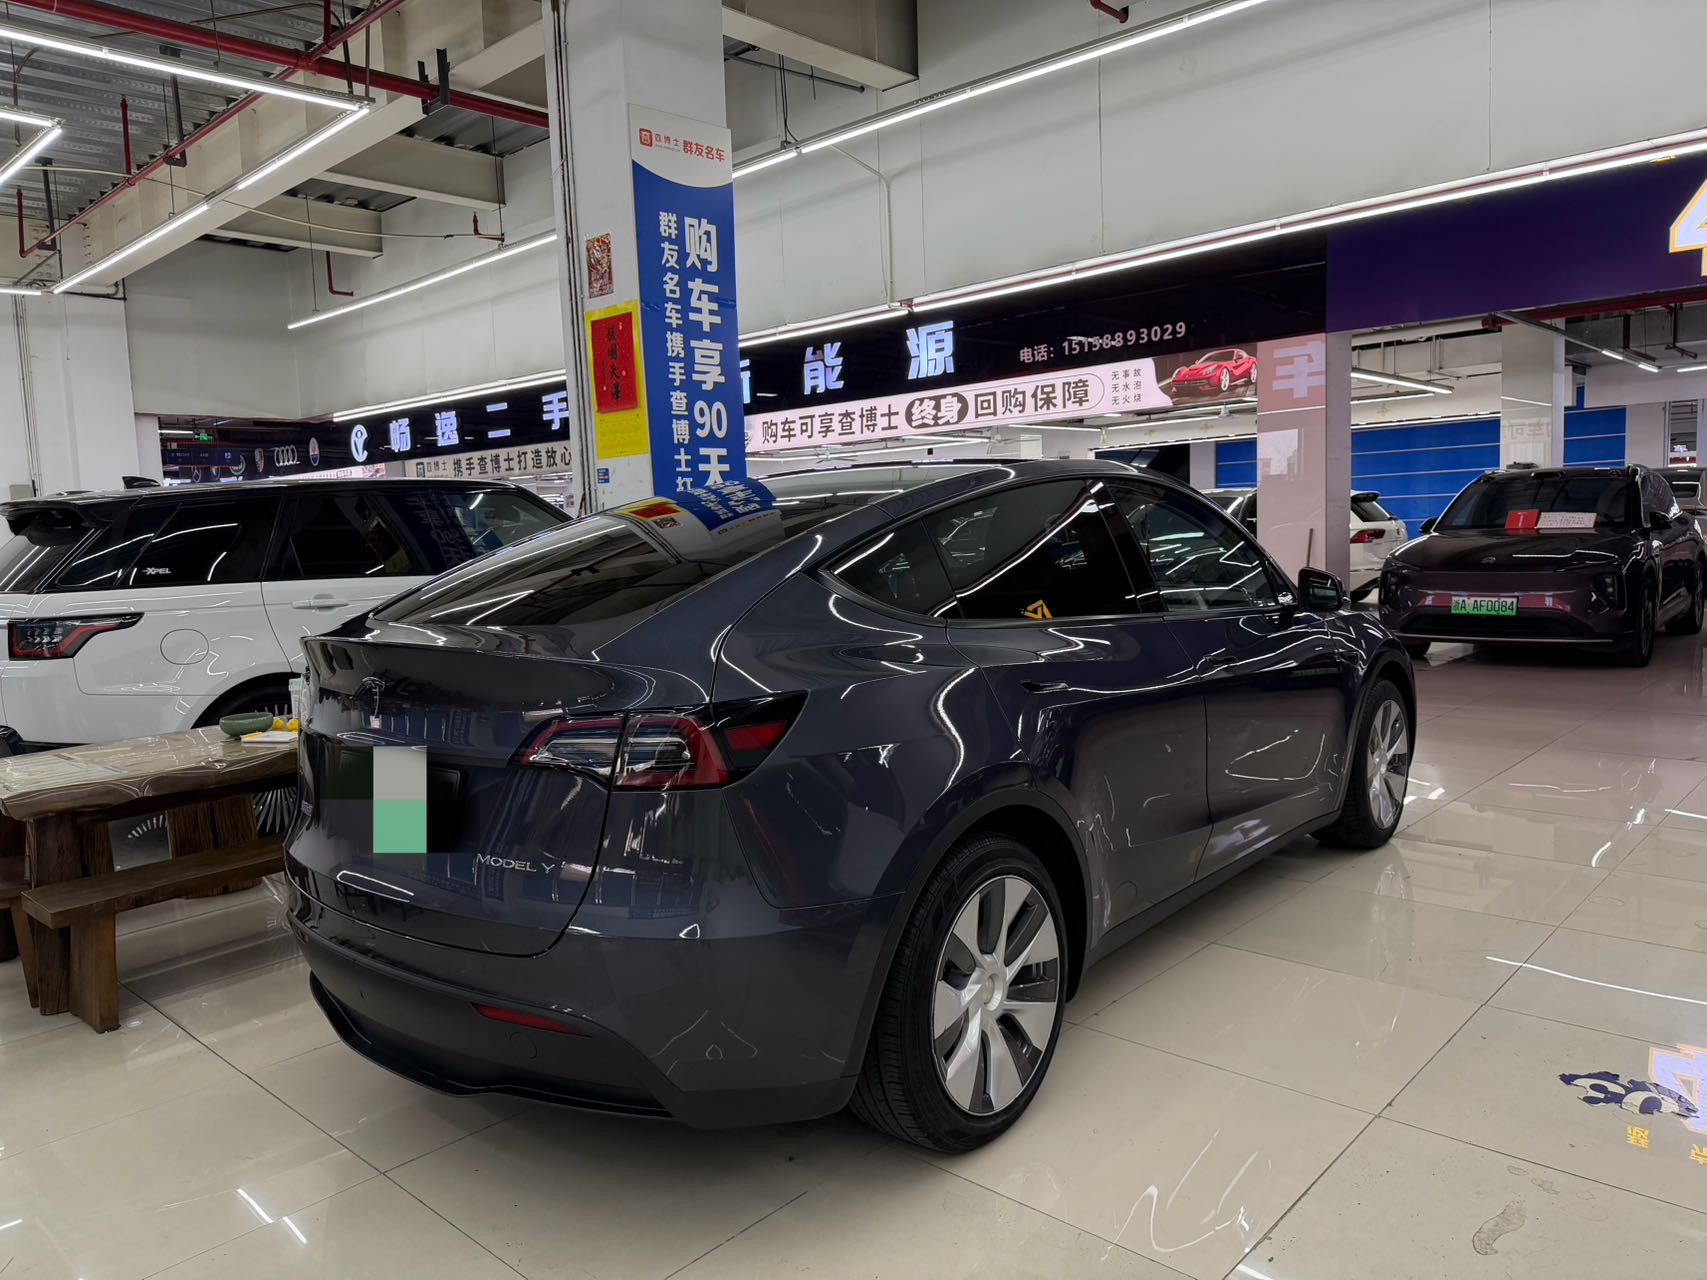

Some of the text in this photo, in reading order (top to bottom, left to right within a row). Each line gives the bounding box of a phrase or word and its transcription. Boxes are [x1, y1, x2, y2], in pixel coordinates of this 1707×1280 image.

[682, 140, 726, 162] 群友名车
[145, 567, 171, 575] XPEL
[476, 853, 555, 874] MODEL Y
